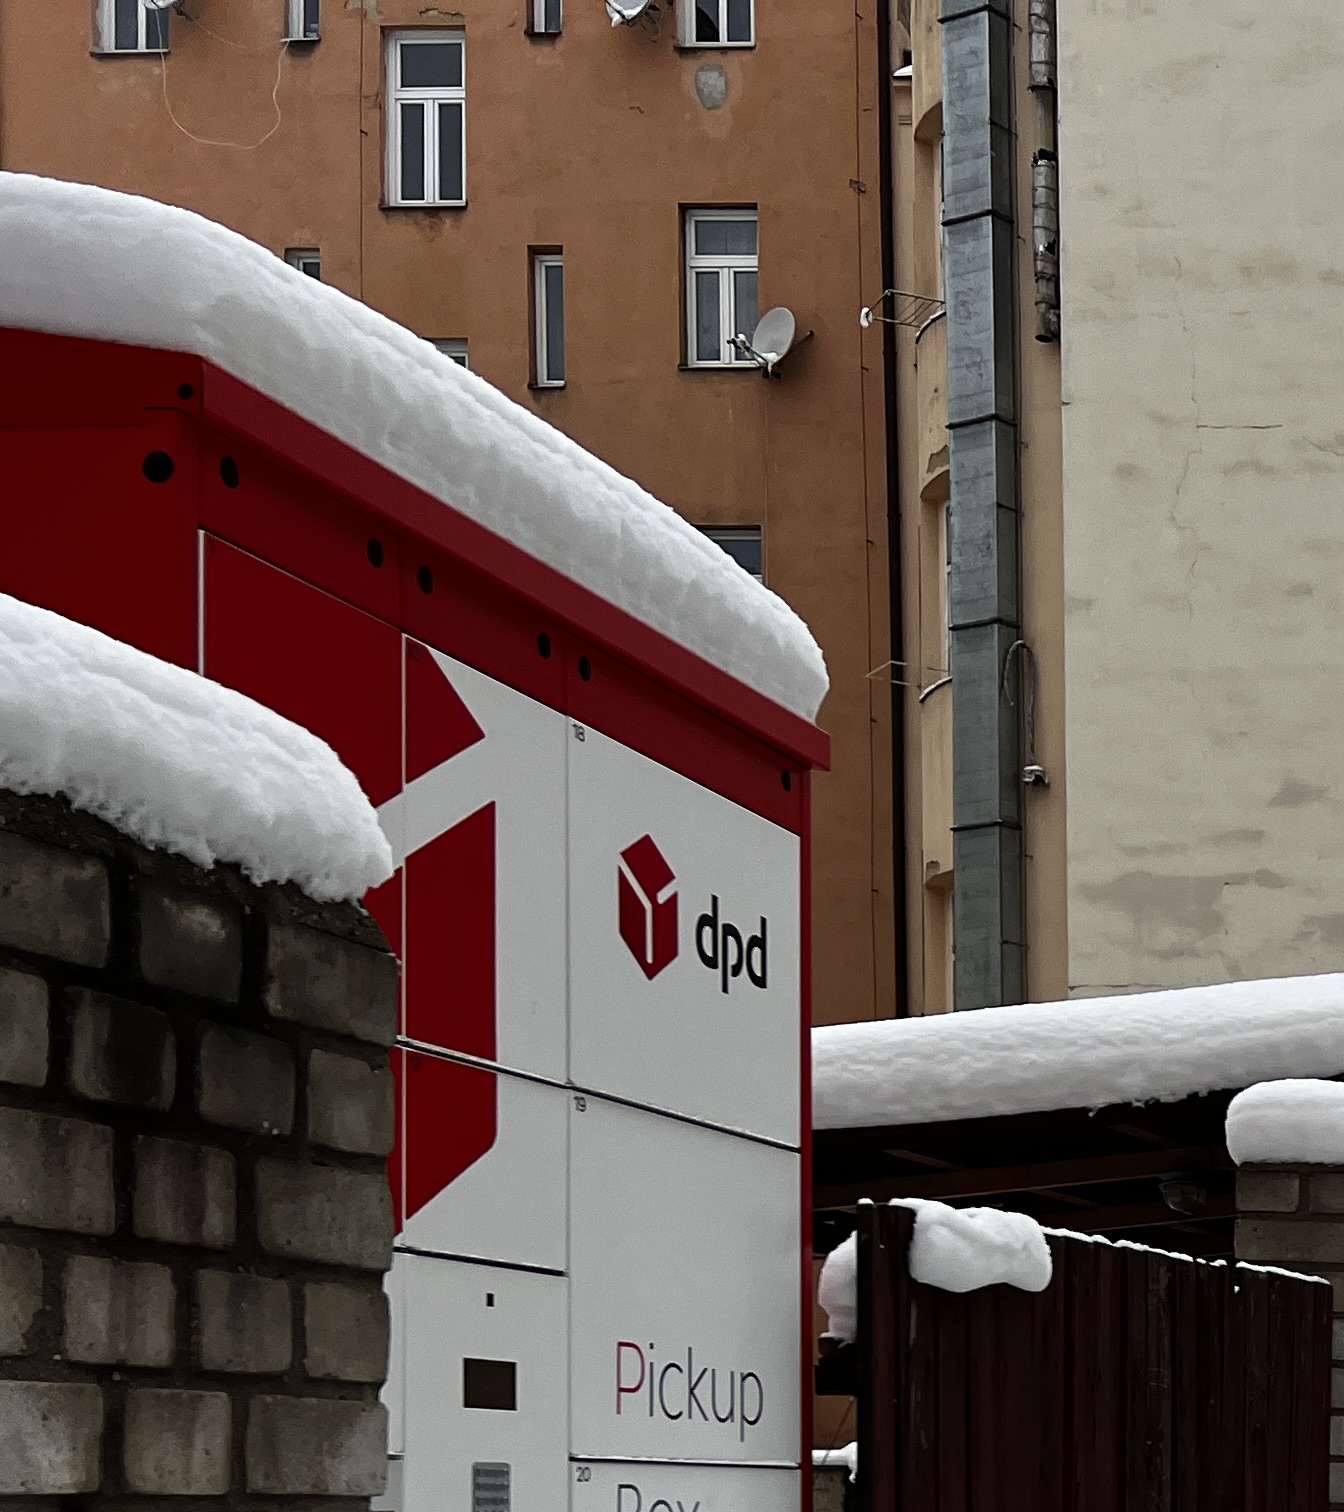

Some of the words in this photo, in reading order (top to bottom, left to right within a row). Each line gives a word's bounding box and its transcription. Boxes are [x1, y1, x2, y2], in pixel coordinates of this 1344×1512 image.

[571, 724, 585, 742] 18
[695, 894, 767, 993] dpd
[615, 1341, 764, 1442] Pickup
[576, 1466, 592, 1482] 20
